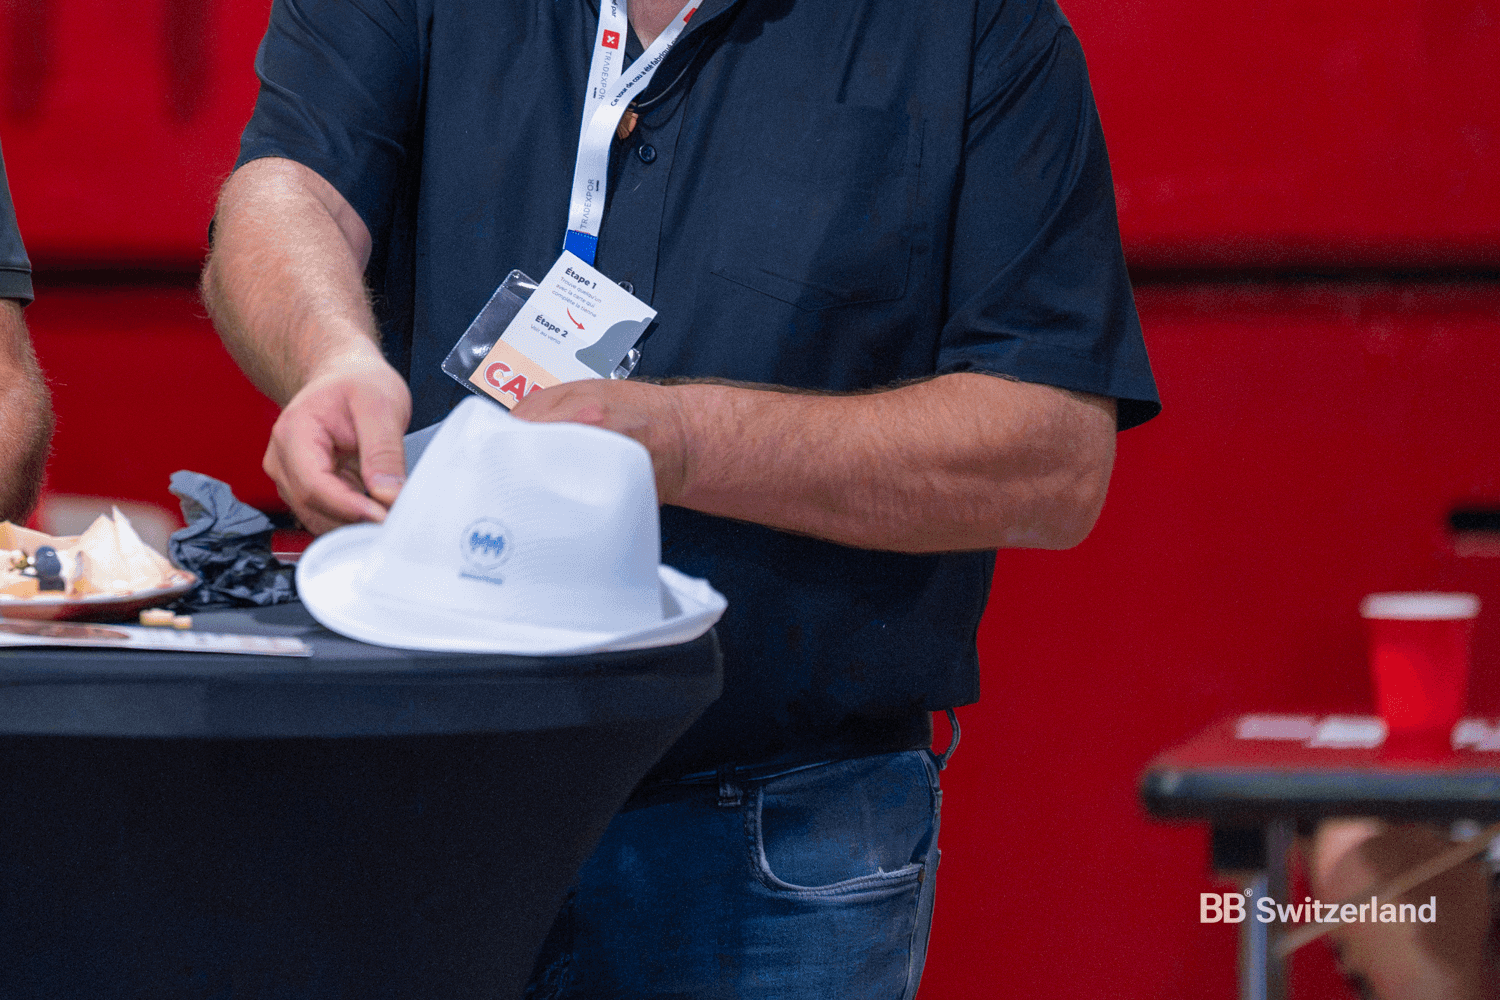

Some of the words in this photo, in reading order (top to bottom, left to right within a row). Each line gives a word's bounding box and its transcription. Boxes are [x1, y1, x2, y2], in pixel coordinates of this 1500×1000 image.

[580, 178, 595, 229] TRADEXPOR
[561, 276, 577, 289] Trouve
[565, 267, 590, 286] Étape
[535, 314, 561, 333] Étape
[561, 329, 569, 338] 2
[484, 361, 545, 402] CA
